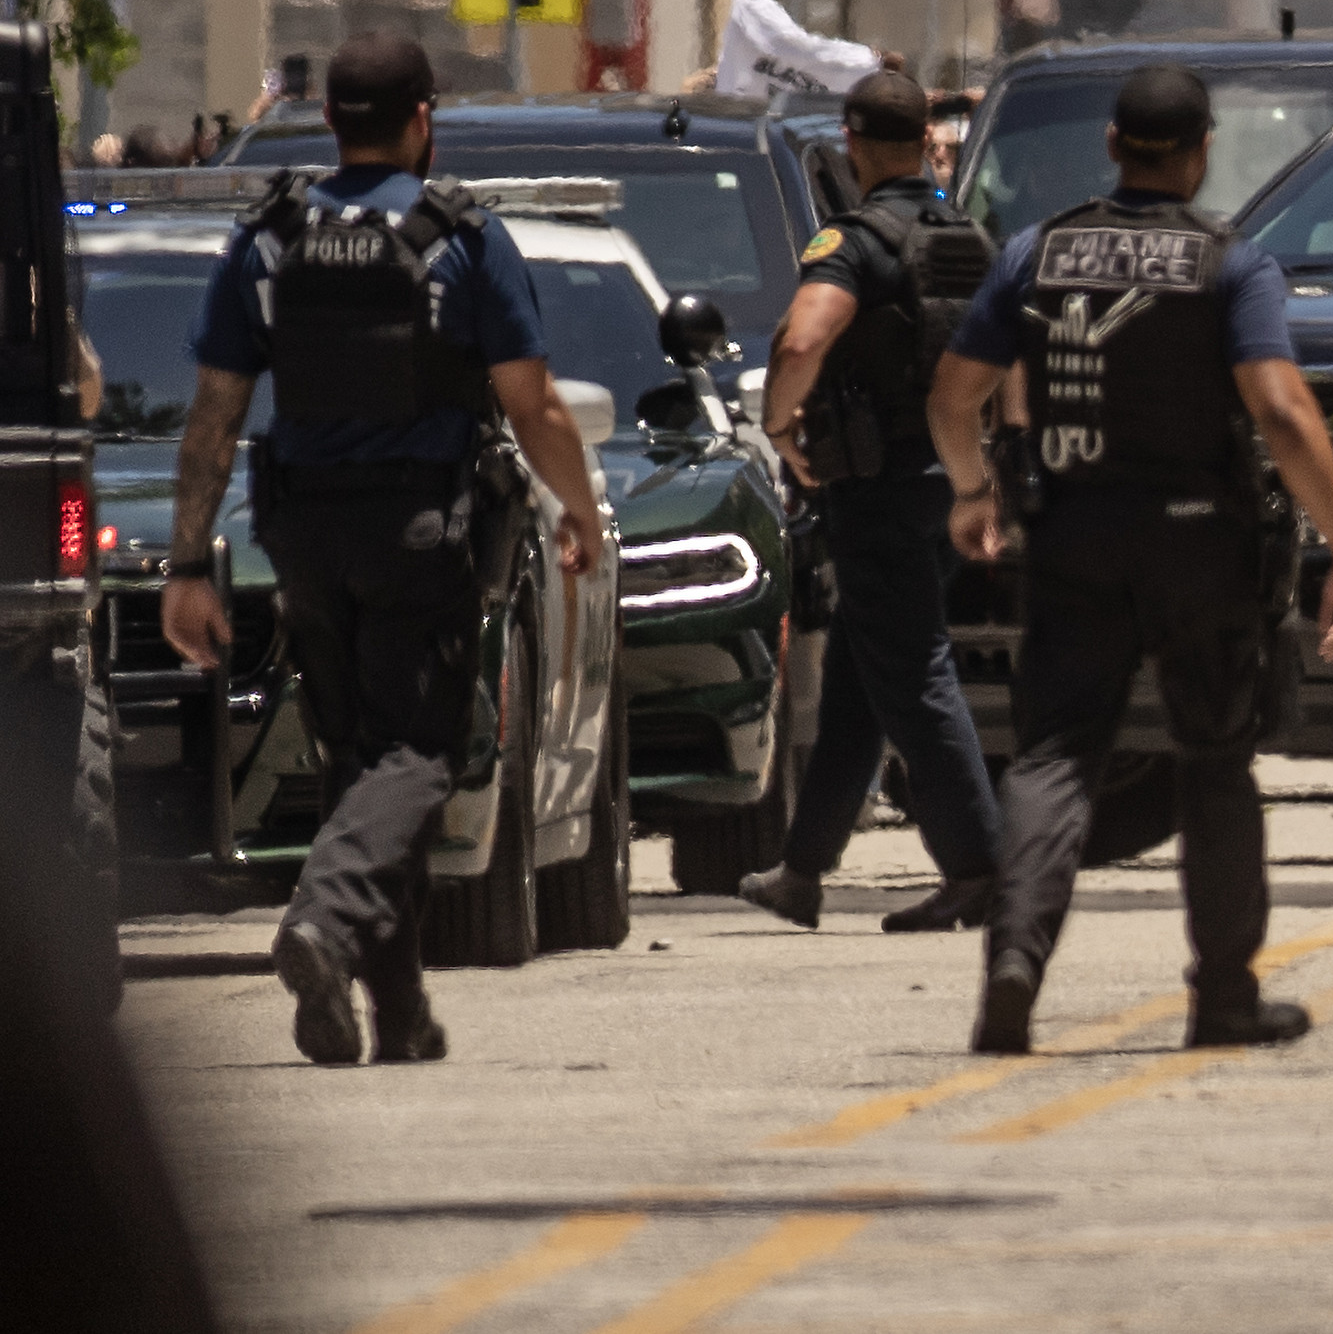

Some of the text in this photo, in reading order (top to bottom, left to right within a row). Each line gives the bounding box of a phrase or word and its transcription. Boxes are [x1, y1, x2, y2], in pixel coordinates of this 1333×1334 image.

[305, 234, 383, 265] POLICE
[1070, 233, 1186, 257] MIAMI
[1055, 253, 1195, 282] POLICE
